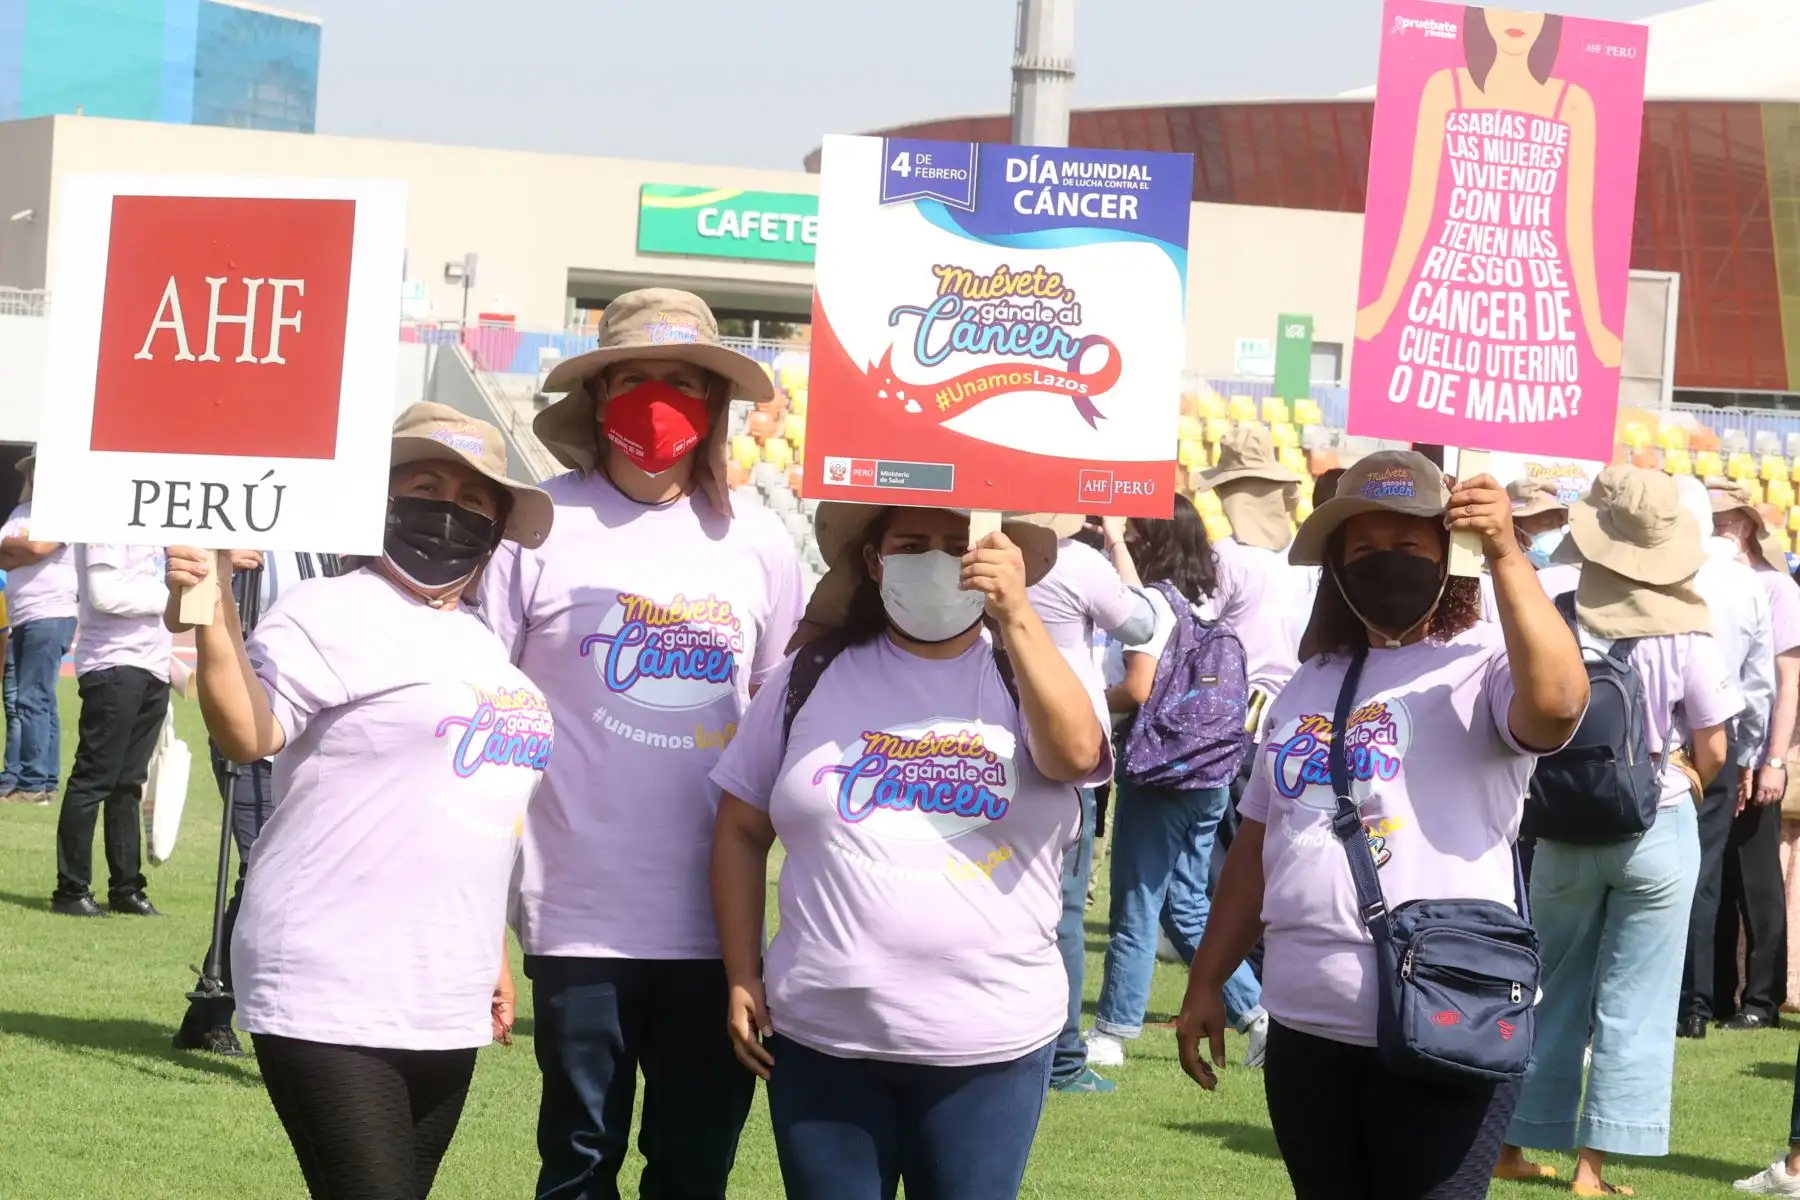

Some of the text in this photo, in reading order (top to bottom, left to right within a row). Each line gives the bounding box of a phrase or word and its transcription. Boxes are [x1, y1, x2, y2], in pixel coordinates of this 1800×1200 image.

[1446, 110, 1569, 146] ¿SABÍAS QUE
[890, 151, 932, 178] 4 DE
[1446, 132, 1565, 169] LAS MUJERES
[915, 167, 968, 180] FEBRERO
[1006, 154, 1152, 185] DÍA MUNDIAL
[1062, 178, 1074, 186] DE
[1075, 179, 1103, 188] LUCHA
[1105, 181, 1138, 189] CONTRA
[1450, 158, 1557, 195] VIVIENDO
[1013, 186, 1138, 220] CÁNCER
[1448, 187, 1552, 226] CON VIH
[1439, 219, 1558, 259] TIENEN MÁS
[932, 264, 1075, 303] Muévete,
[1420, 246, 1568, 289] RIESGO DE
[133, 275, 305, 366] AHF
[977, 299, 1082, 326] gánale al
[1407, 281, 1577, 342] CÁNCER DE
[888, 294, 1081, 367] Cáncer
[1398, 325, 1578, 383] CUELLO UTERINO
[935, 369, 1089, 412] #UnamosLazos
[1388, 364, 1582, 424] O DE MAMA?
[880, 470, 909, 478] Ministerio
[1083, 478, 1156, 496] AHF PERÚ
[127, 469, 287, 533] PERÚ
[617, 592, 742, 631] Muévete,
[662, 626, 729, 650] gánale
[862, 730, 997, 764] Muévete,
[1374, 721, 1398, 745] al
[812, 754, 1009, 823] Cáncer
[904, 760, 1006, 786] gánale al
